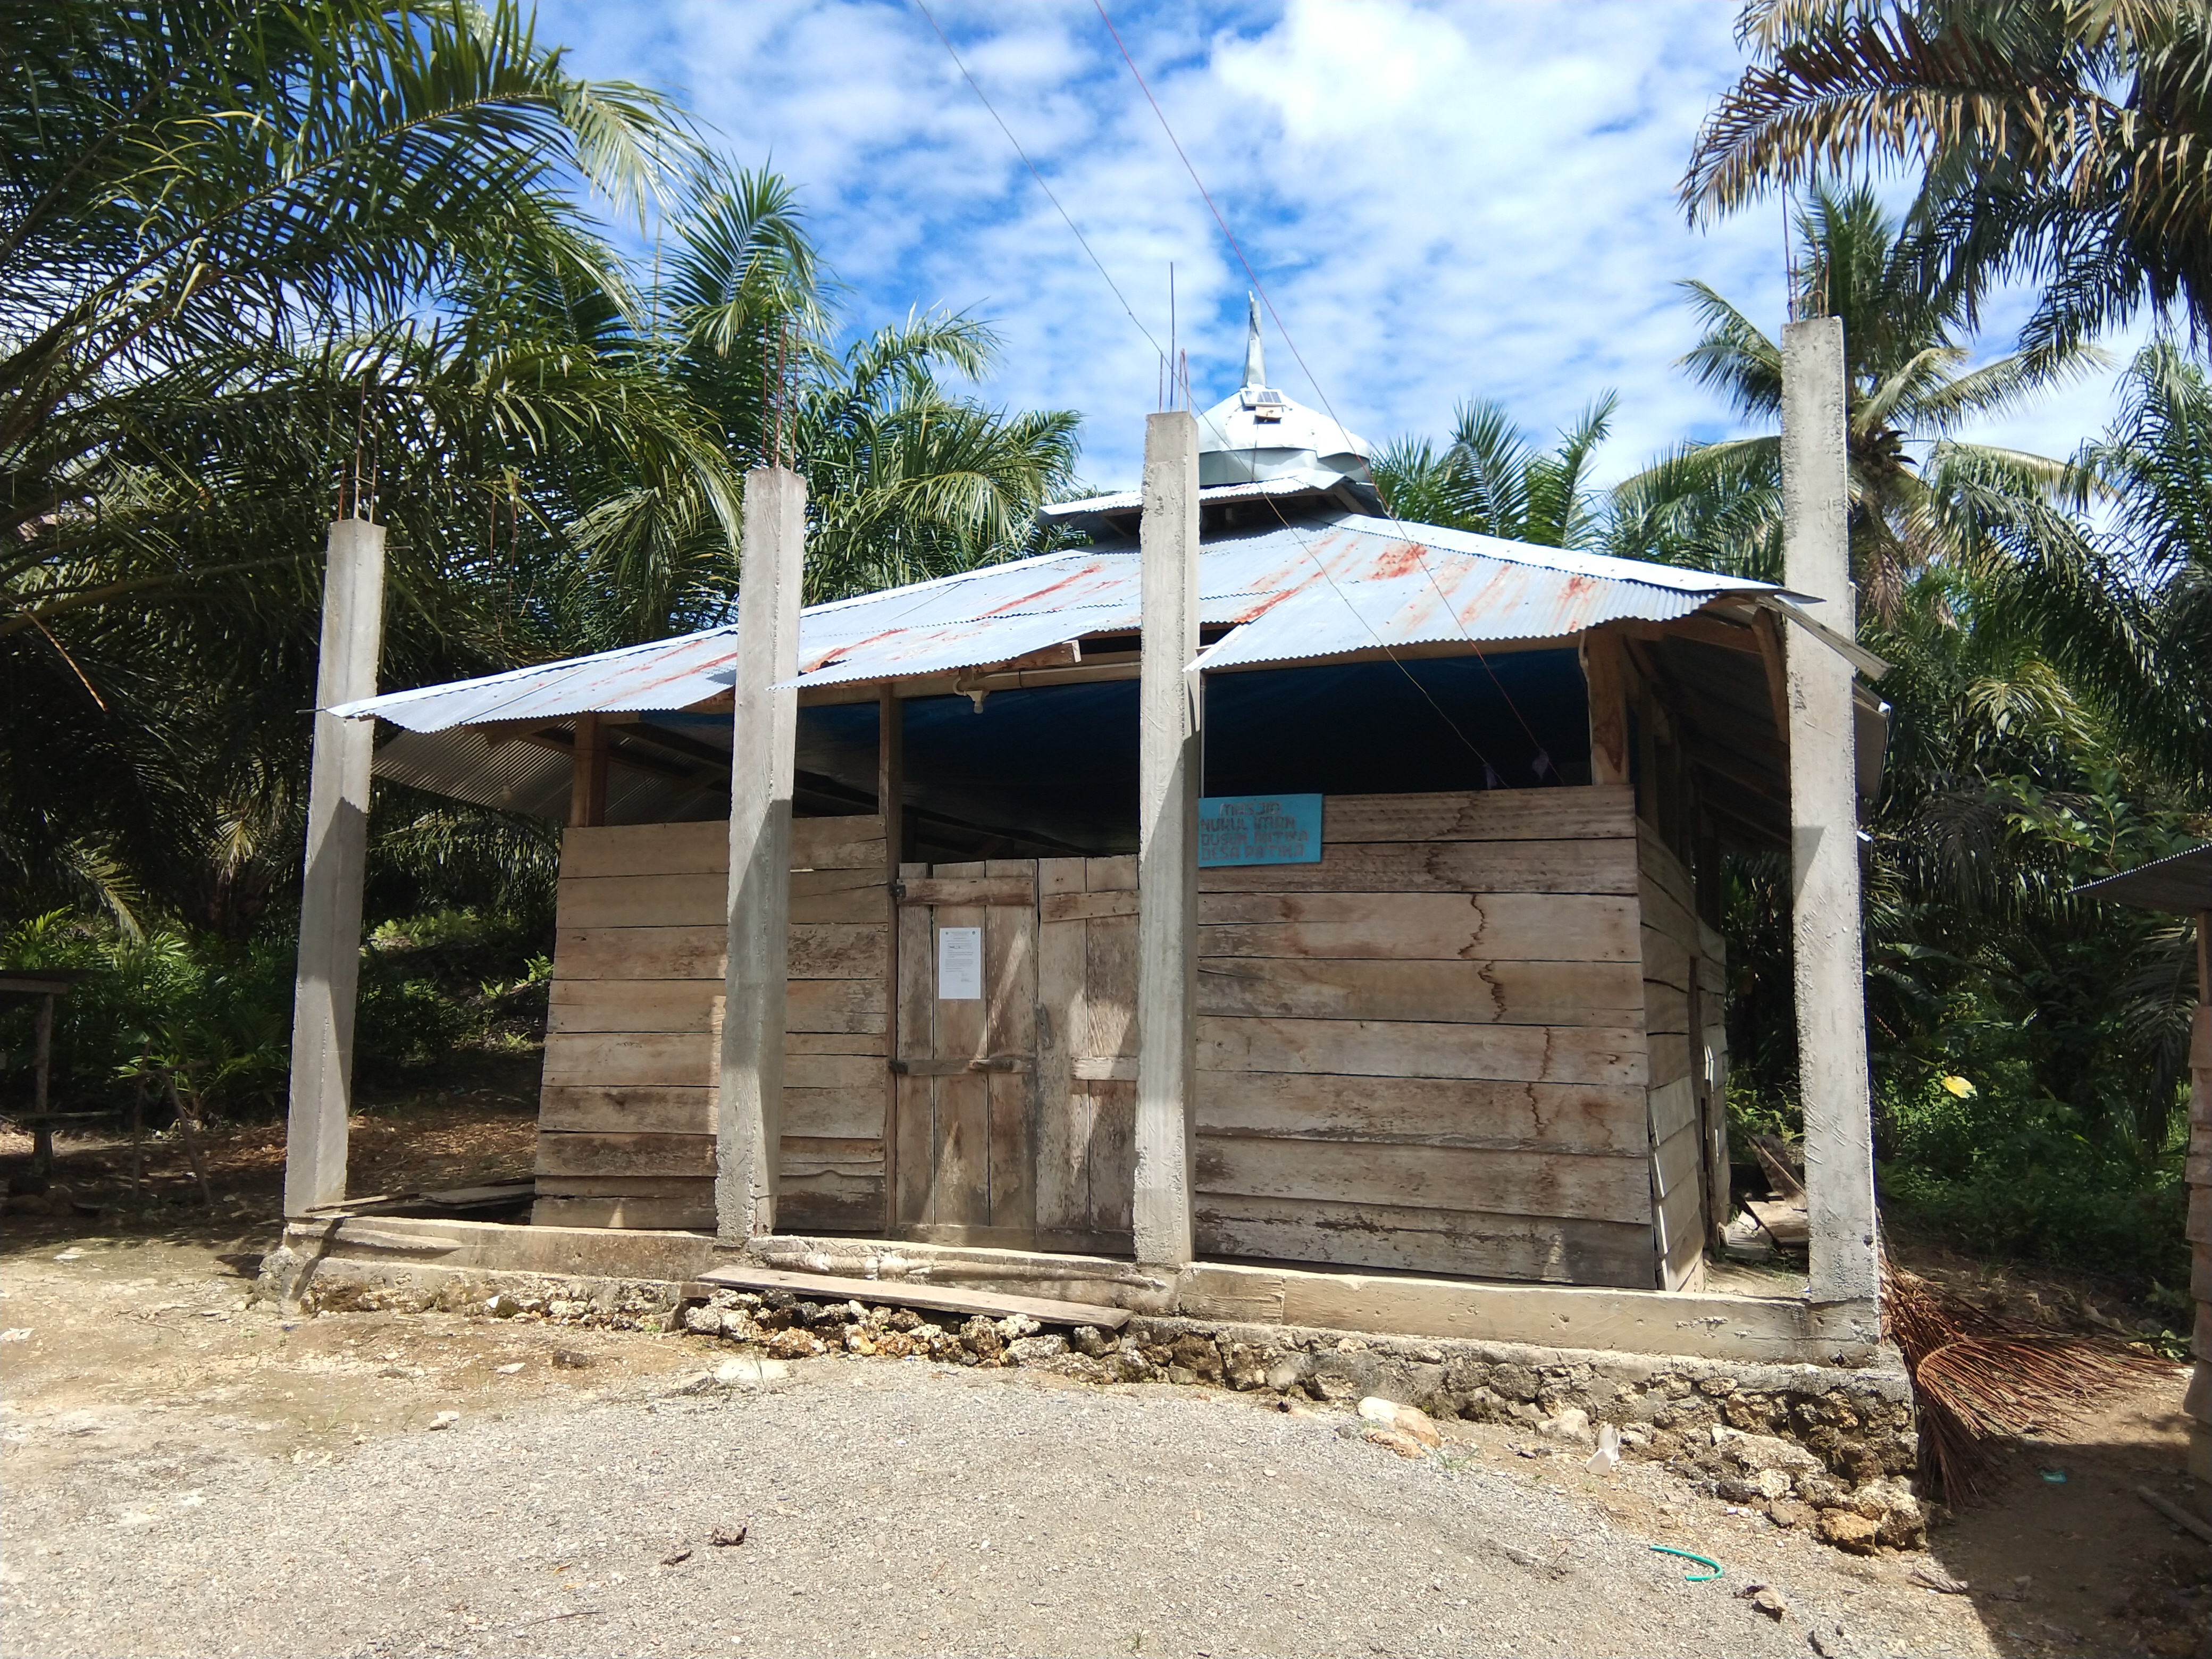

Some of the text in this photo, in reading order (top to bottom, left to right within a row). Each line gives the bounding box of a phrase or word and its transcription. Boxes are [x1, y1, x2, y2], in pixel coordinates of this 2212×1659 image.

[1220, 802, 1280, 817] MASJID
[1201, 816, 1295, 832] NURUL IMAN
[1201, 833, 1247, 846] DUSUN
[1201, 846, 1239, 860] DESA
